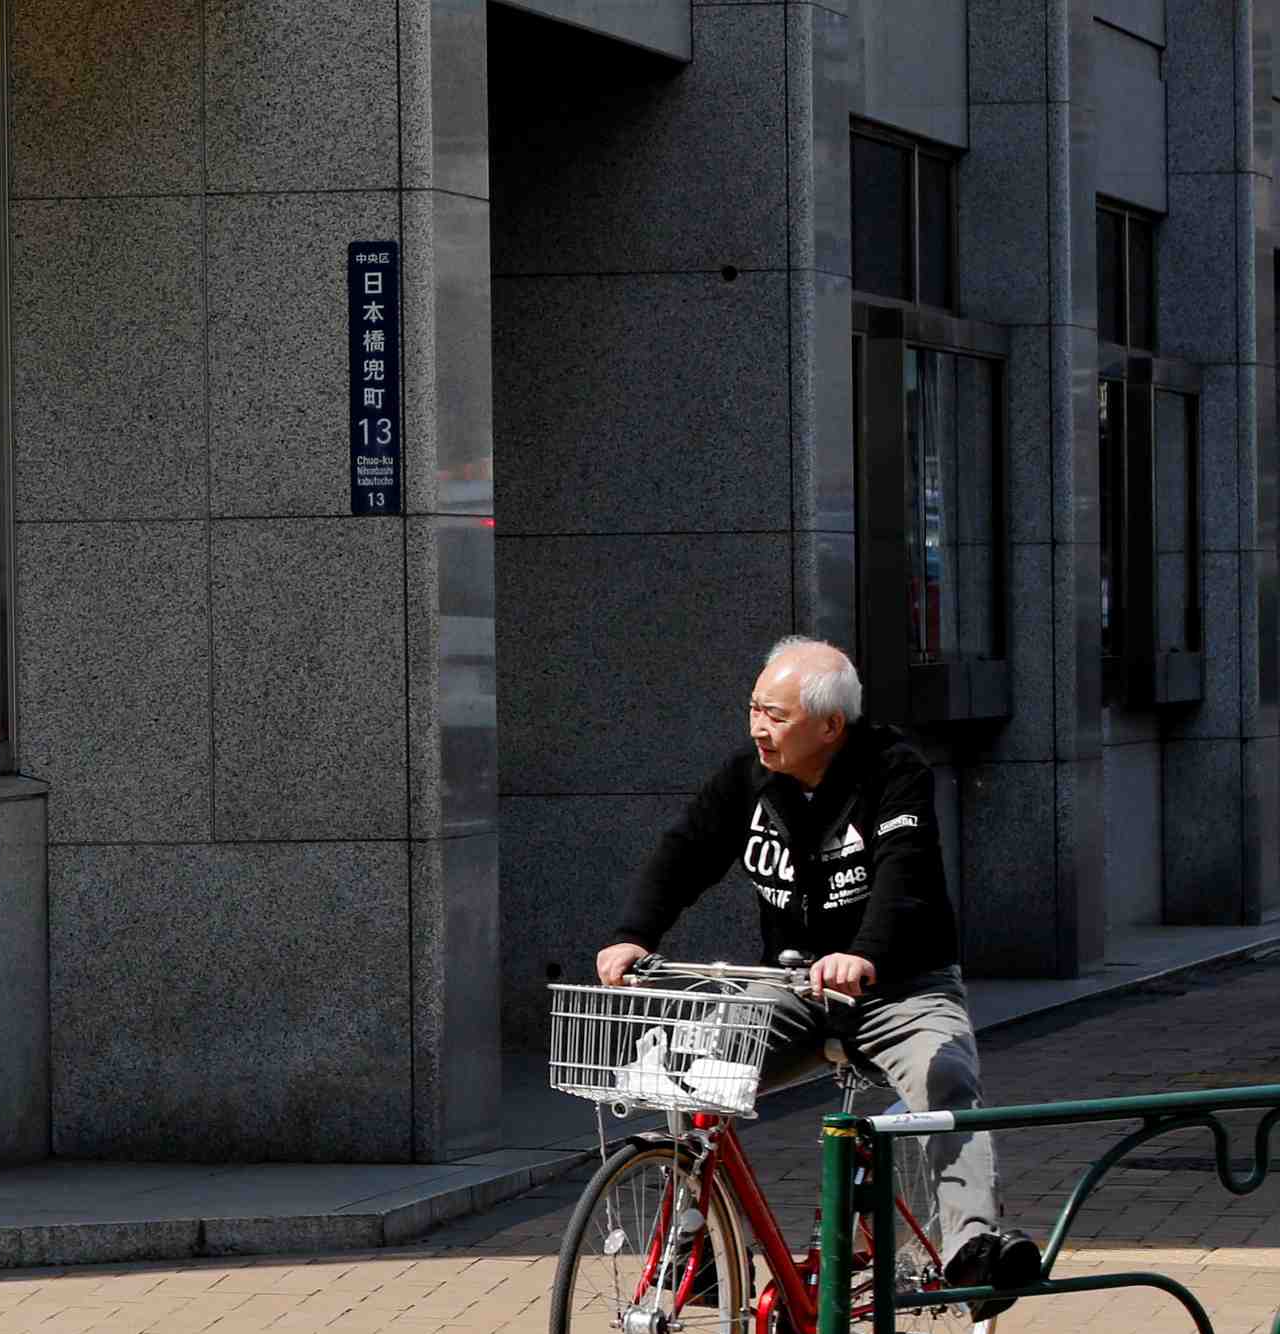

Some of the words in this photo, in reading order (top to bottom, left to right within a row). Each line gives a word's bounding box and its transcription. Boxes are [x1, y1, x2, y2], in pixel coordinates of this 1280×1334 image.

[355, 252, 391, 264] 中央区
[362, 271, 385, 409] 日本橋兜町
[358, 418, 392, 446] 13
[368, 492, 385, 507] 13
[828, 866, 867, 890] 1948
